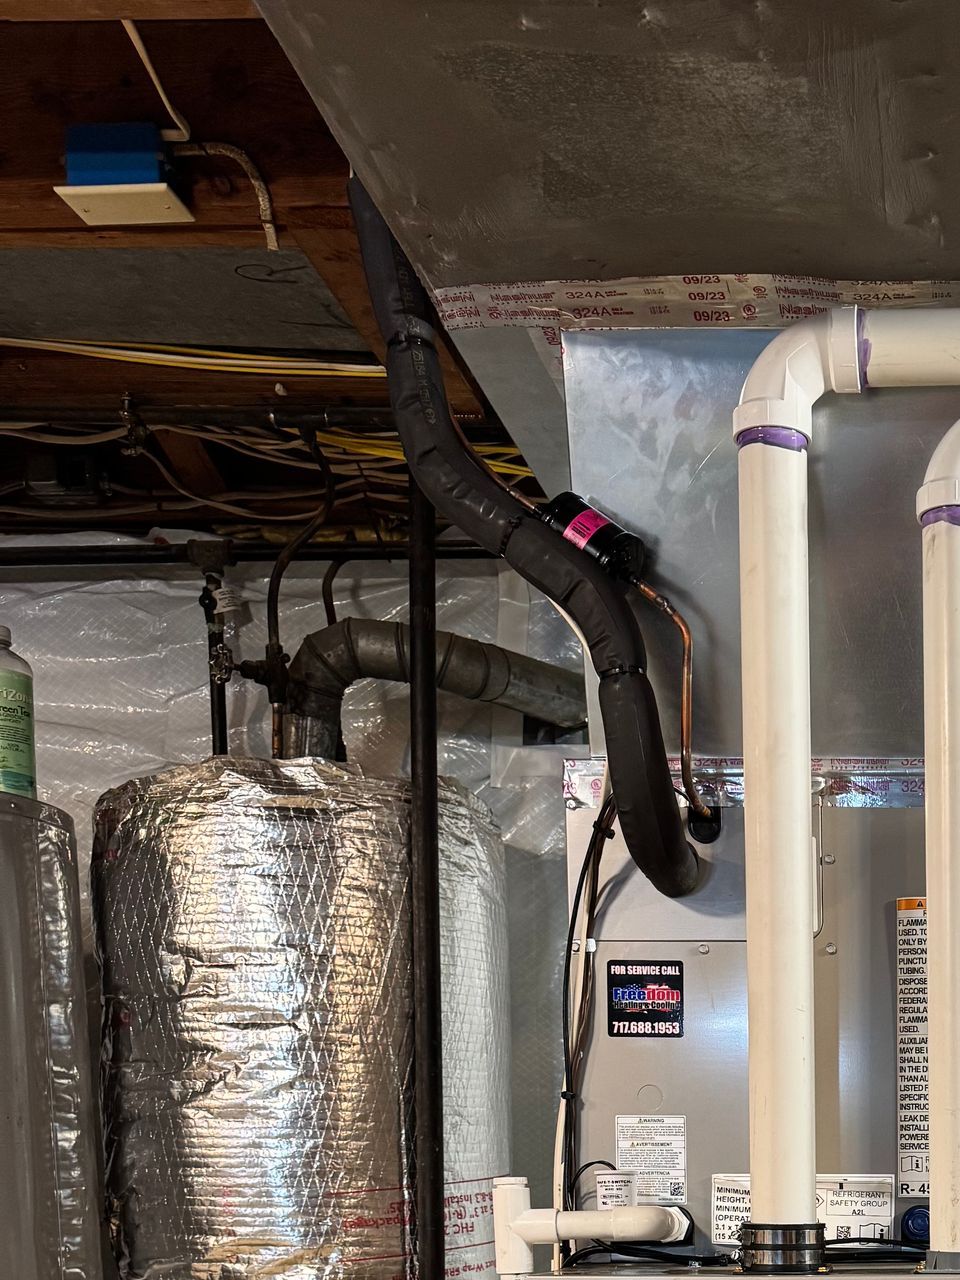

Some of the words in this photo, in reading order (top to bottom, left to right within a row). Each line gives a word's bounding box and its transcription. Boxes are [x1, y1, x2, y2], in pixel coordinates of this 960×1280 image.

[682, 275, 721, 285] 09/23
[565, 291, 606, 299] 324A
[688, 291, 726, 301] 09/23
[853, 293, 893, 301] 324A
[572, 306, 612, 319] 324A
[693, 310, 731, 322] 09/23
[898, 928, 919, 936] USED.
[898, 938, 917, 946] ONLY
[610, 965, 626, 975] FOR
[627, 965, 660, 975] SERVICE
[661, 965, 680, 975] CALL
[898, 967, 926, 975] TUBING.
[612, 986, 681, 1002] Freedom
[612, 1021, 680, 1034] 717.688.1953
[899, 1056, 921, 1064] SHALL
[899, 1084, 923, 1092] LISTED
[899, 1114, 918, 1122] LEAK
[716, 1186, 750, 1196] MINIMUM
[832, 1190, 886, 1199] REFRIGERANT
[716, 1195, 747, 1205] HEIGHT,
[829, 1199, 859, 1208] SAFETY
[860, 1200, 888, 1208] GROUP
[716, 1205, 750, 1214] MINIMUM
[452, 1221, 475, 1234] FHC
[715, 1232, 726, 1241] (15
